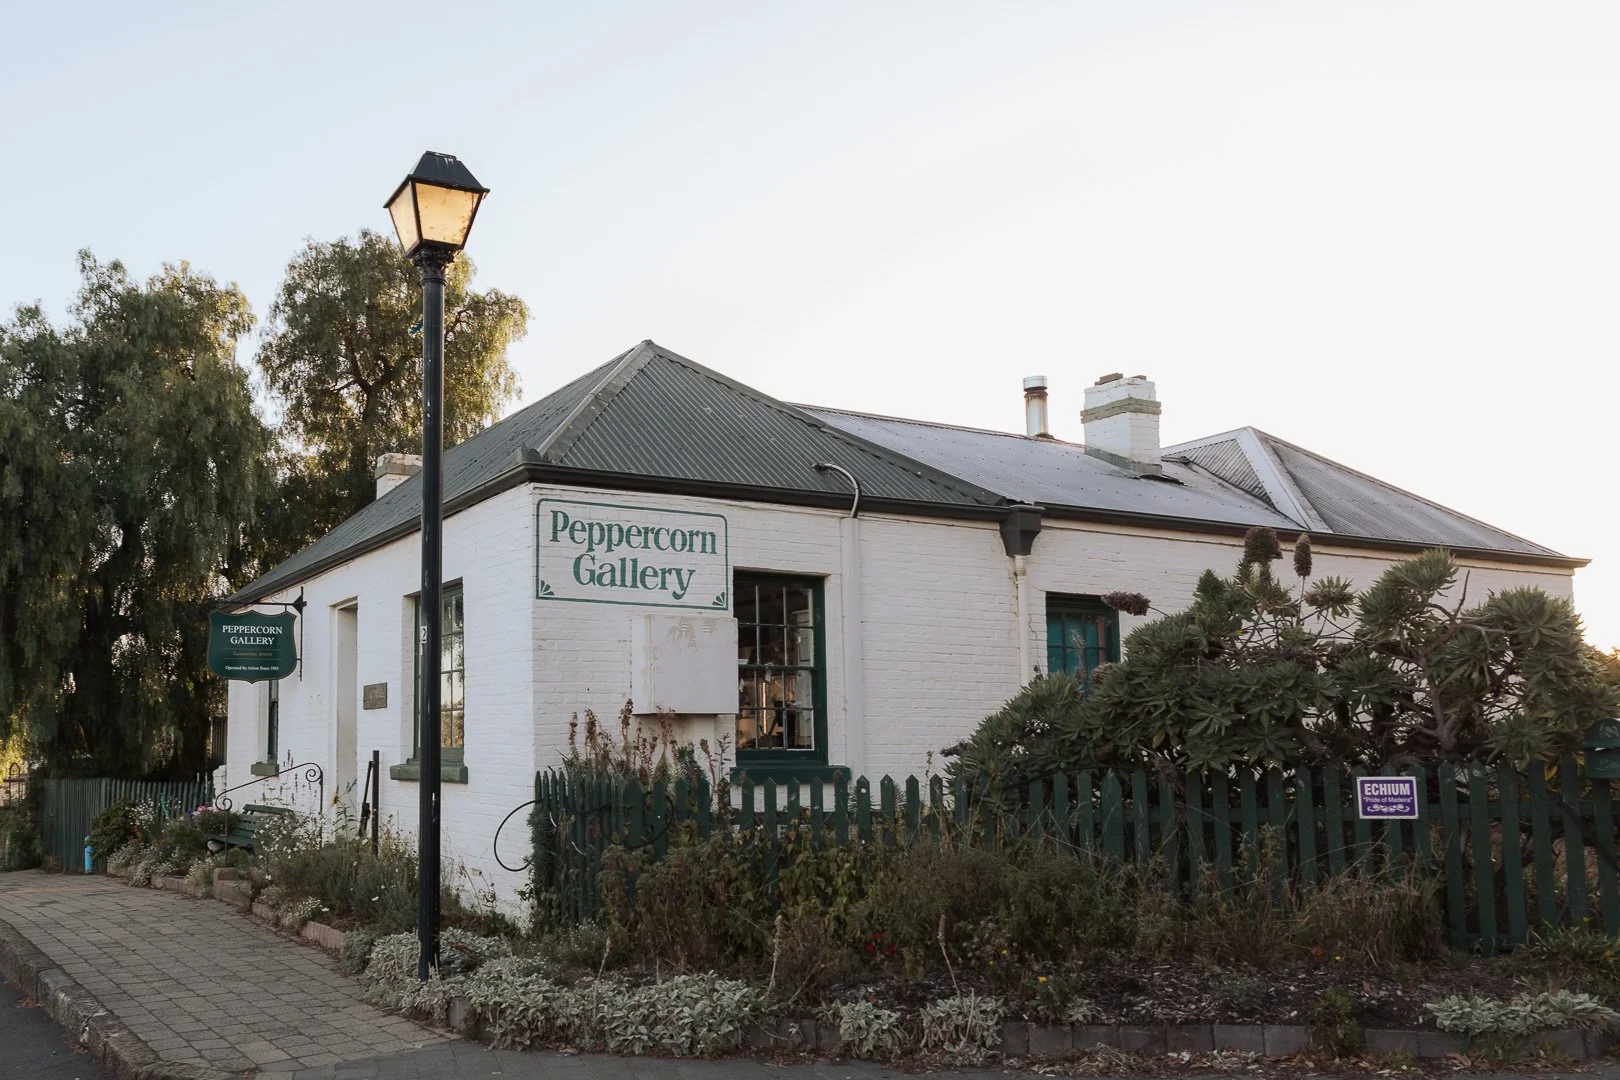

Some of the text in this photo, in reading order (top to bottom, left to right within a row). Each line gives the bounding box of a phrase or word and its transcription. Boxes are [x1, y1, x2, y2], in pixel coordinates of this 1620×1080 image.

[549, 510, 718, 554] Peppercorn
[573, 553, 696, 600] Gallery
[222, 625, 283, 634] PEPPERCORN
[230, 636, 275, 645] GALLERY
[1364, 783, 1411, 795] ECHIUM
